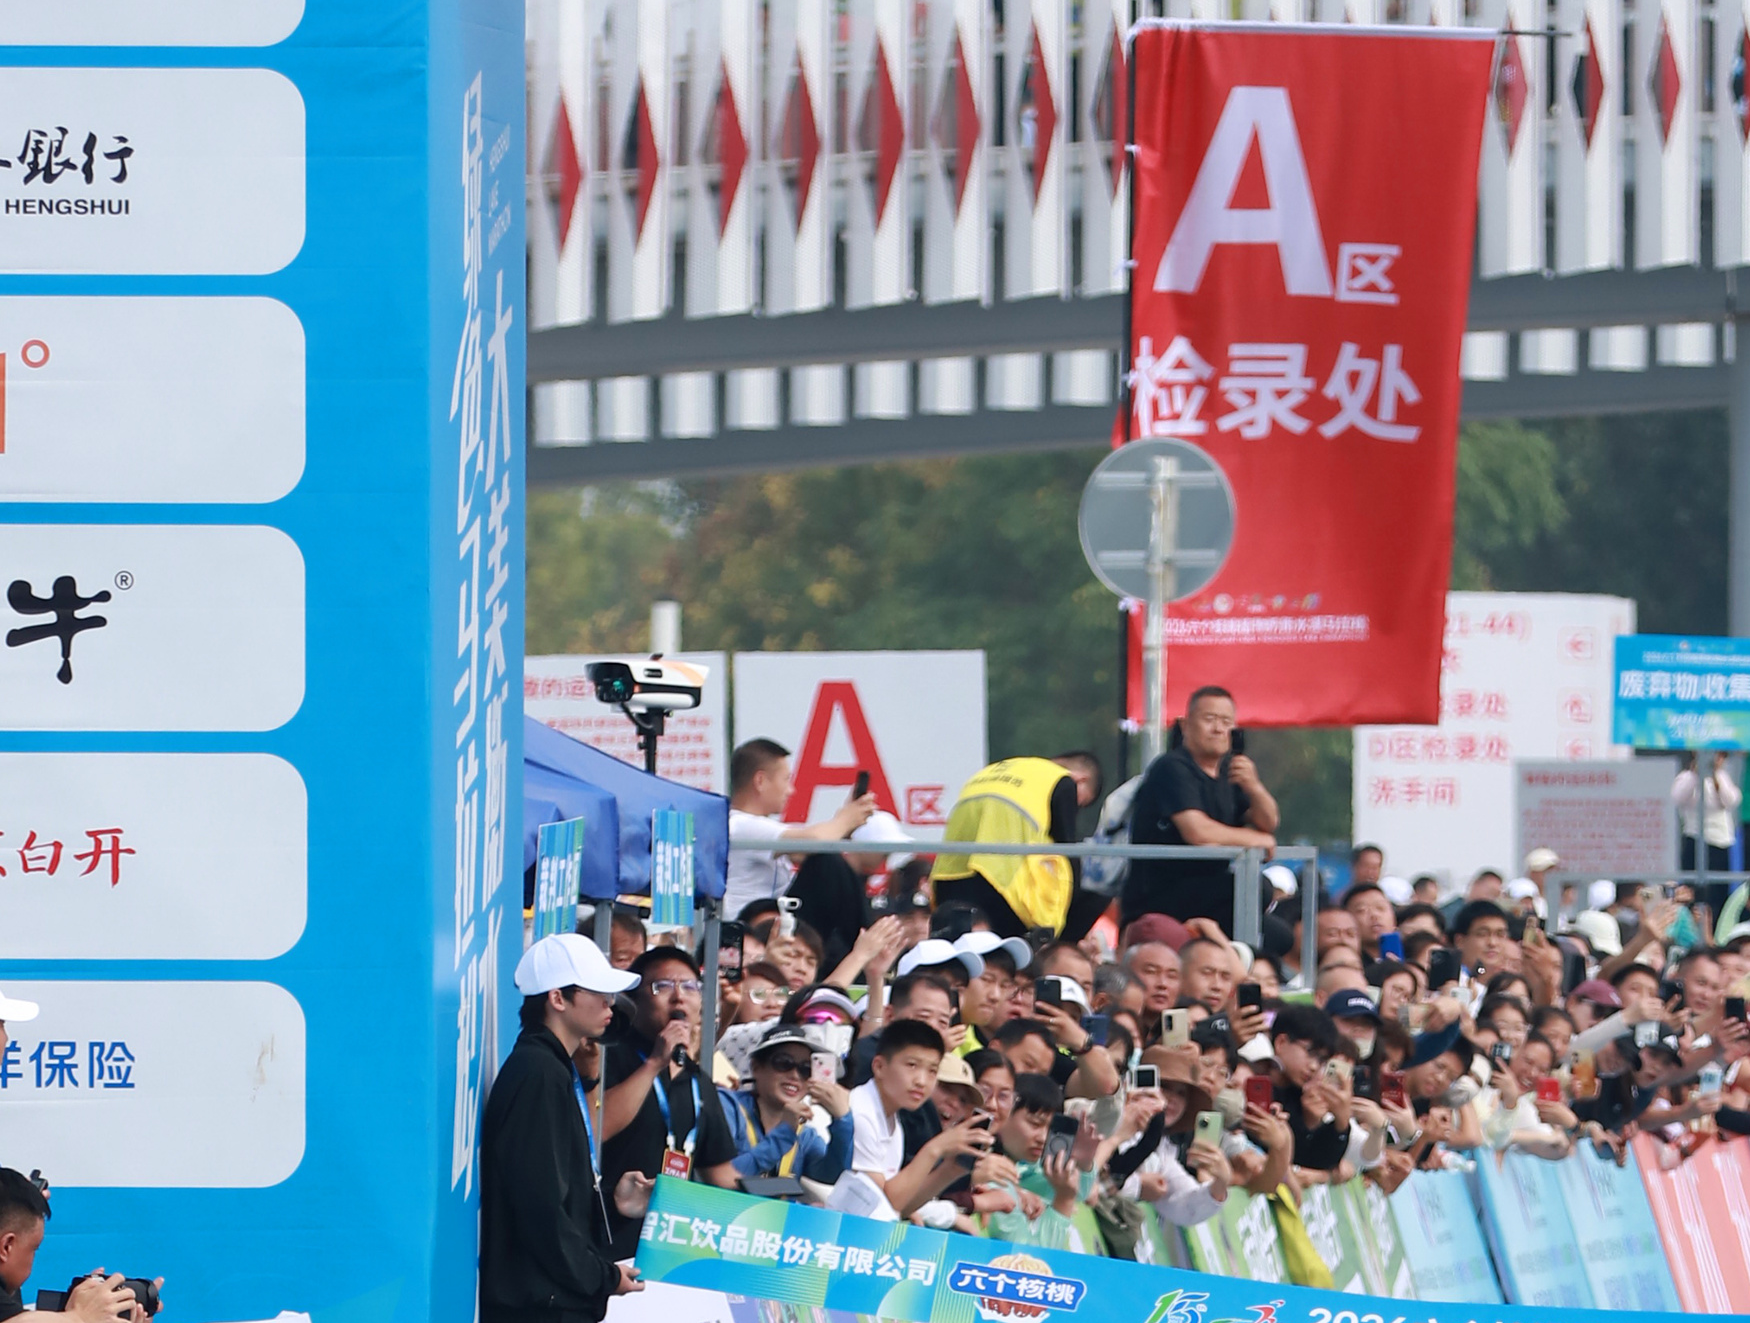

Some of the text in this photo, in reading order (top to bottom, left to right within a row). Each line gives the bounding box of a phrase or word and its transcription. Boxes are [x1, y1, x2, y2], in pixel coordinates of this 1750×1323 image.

[5, 199, 131, 215] HENGSHUI
[1152, 86, 1402, 305] A区
[1131, 335, 1422, 442] 检录处
[449, 70, 485, 1193] 绿色马拉松
[462, 270, 513, 1305] 大美衡水
[0, 827, 137, 888] 白开
[957, 1267, 1077, 1308] 六个核桃
